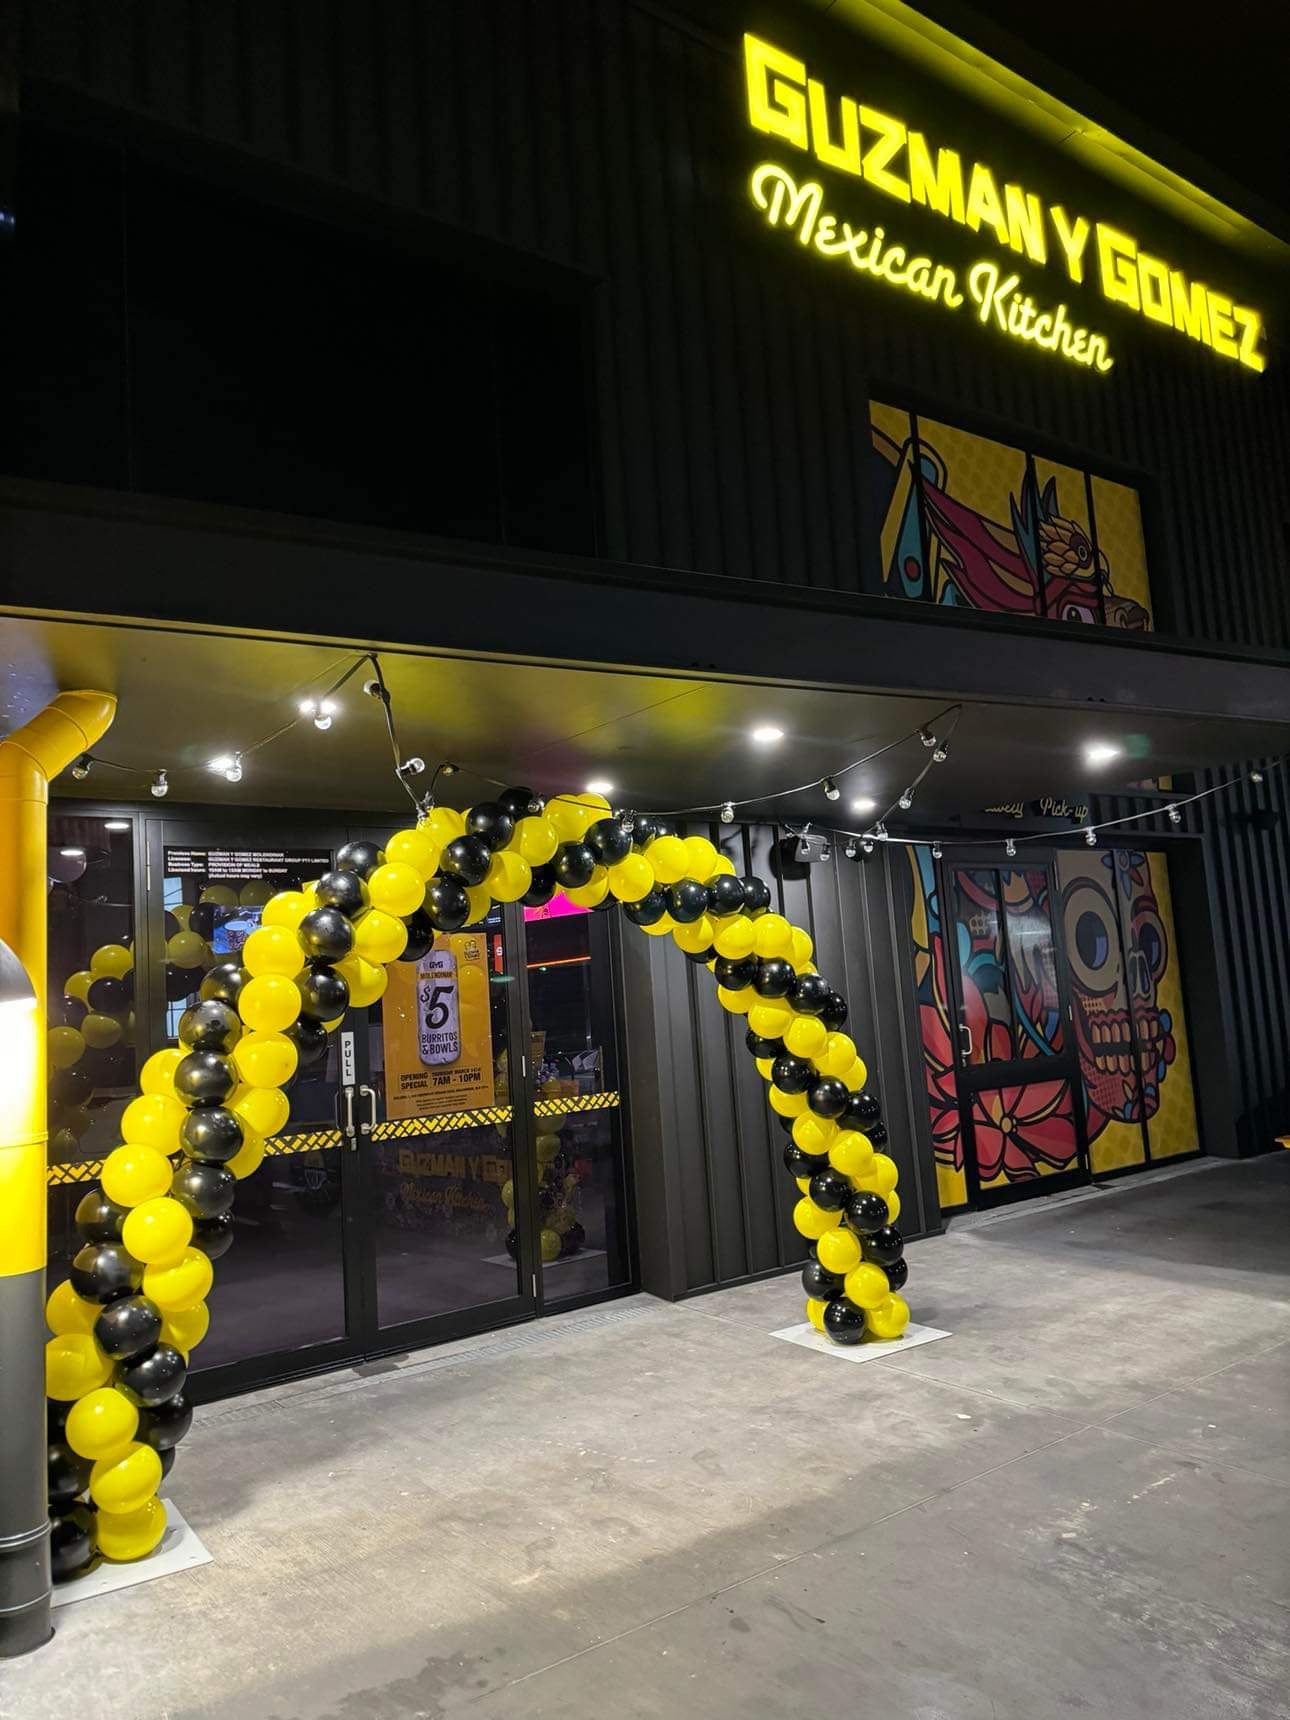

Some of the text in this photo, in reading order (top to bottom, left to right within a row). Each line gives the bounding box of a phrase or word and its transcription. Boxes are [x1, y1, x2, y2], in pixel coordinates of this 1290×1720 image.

[744, 32, 1266, 374] GUZMAN Y GOMEZ
[751, 162, 1115, 373] Mexican Kitchen
[1040, 797, 1089, 824] Pick-up
[420, 984, 455, 1030] $5
[421, 1031, 458, 1044] BURRITOS
[344, 1040, 352, 1077] PULL
[400, 1072, 429, 1082] OPENING
[400, 1081, 429, 1090] SPECIAL
[432, 1075, 451, 1087] 7AM
[459, 1071, 482, 1084] 10PM
